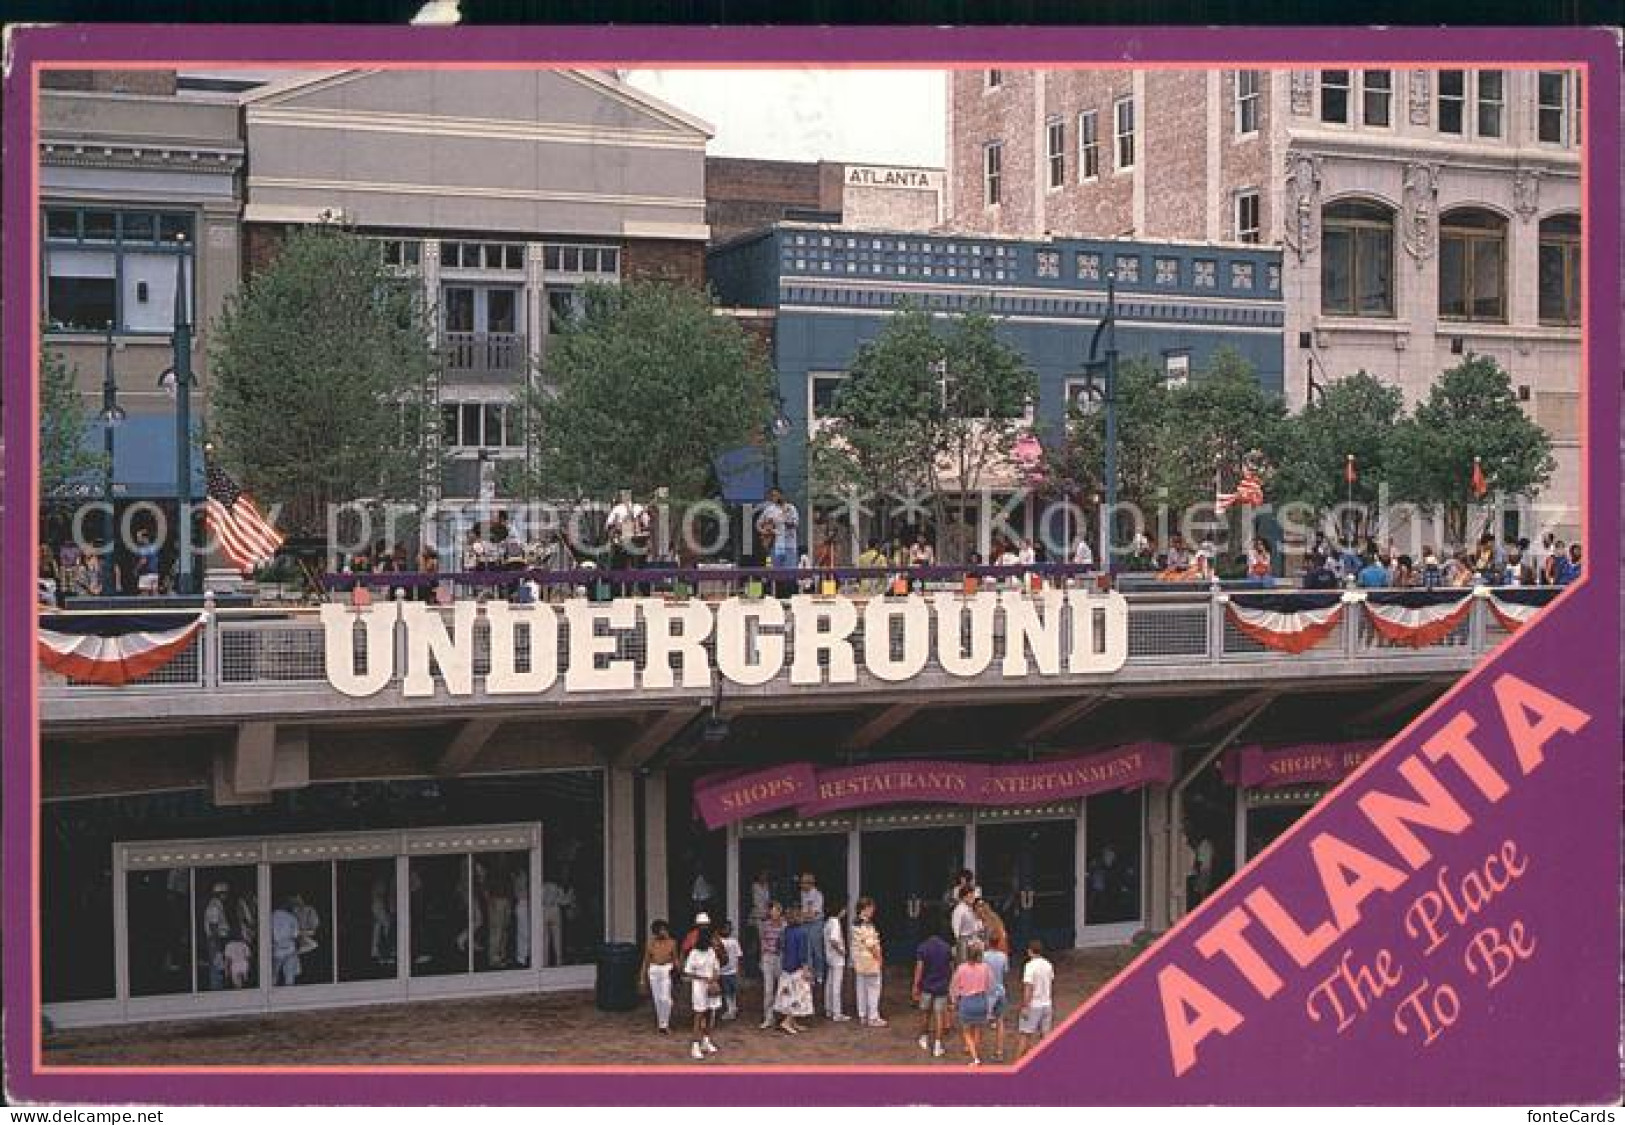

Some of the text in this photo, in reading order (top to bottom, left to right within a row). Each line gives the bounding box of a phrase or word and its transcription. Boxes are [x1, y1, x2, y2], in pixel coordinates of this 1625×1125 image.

[849, 168, 930, 187] ATLANTA
[321, 588, 1129, 698] UNDERGROUND
[820, 771, 967, 800] RESTAURANTS
[1157, 672, 1593, 1078] ATLANTA
[1306, 838, 1529, 1034] The Place
[1393, 917, 1536, 1047] To Be
